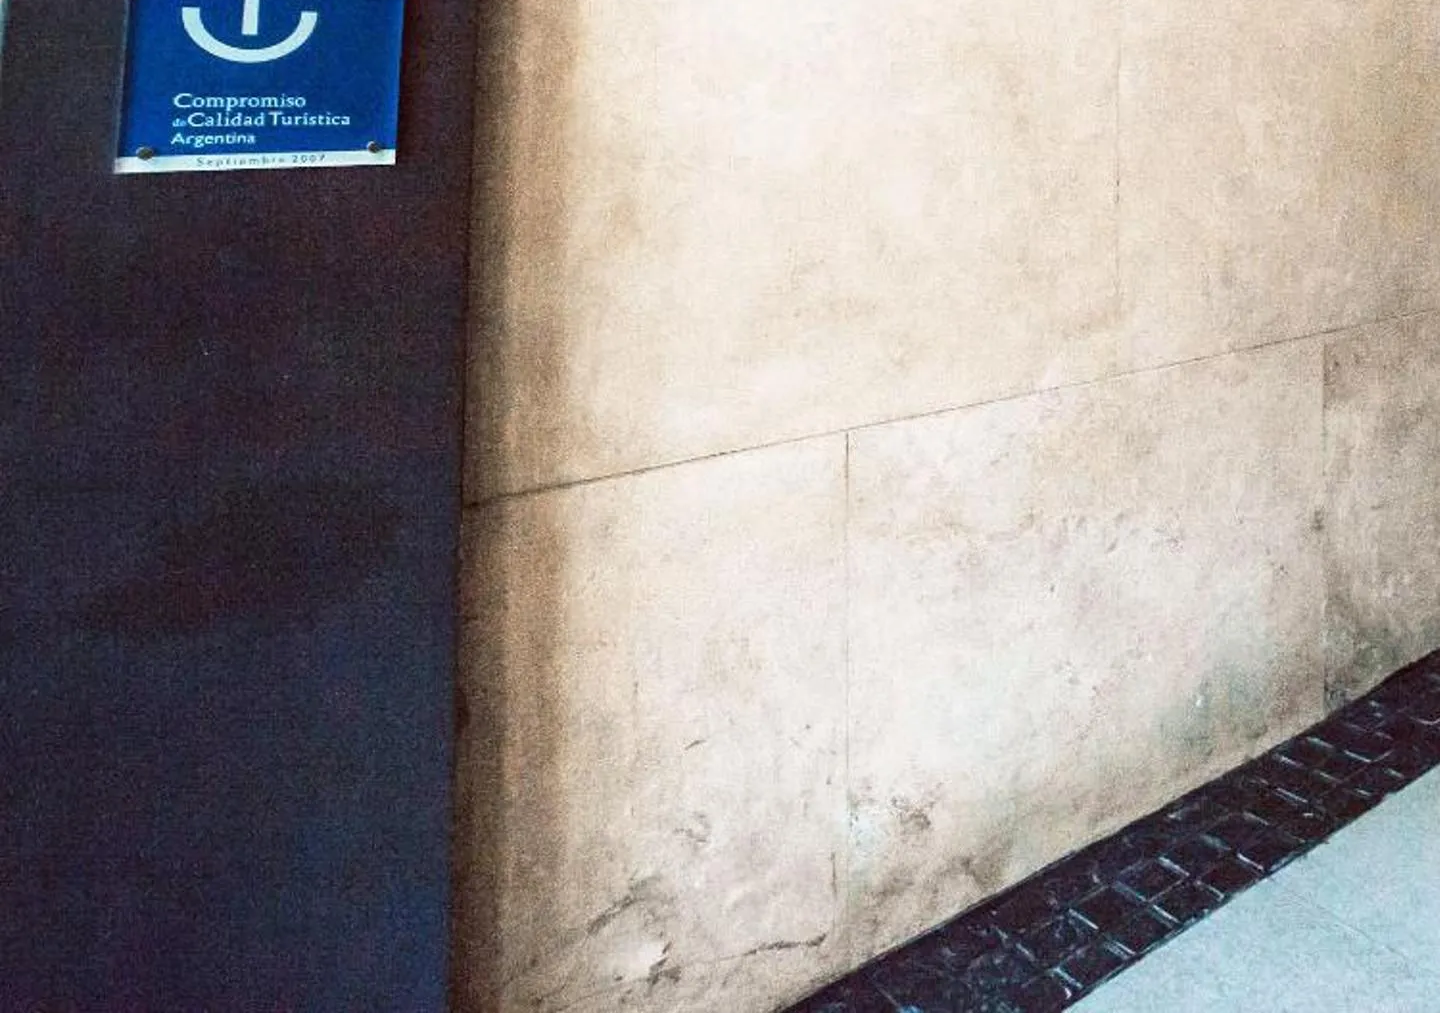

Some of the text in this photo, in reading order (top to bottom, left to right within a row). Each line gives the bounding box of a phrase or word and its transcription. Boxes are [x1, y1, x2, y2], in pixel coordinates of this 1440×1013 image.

[173, 92, 307, 112] Compromiso
[187, 111, 265, 128] Calidad
[170, 132, 256, 148] Argentina
